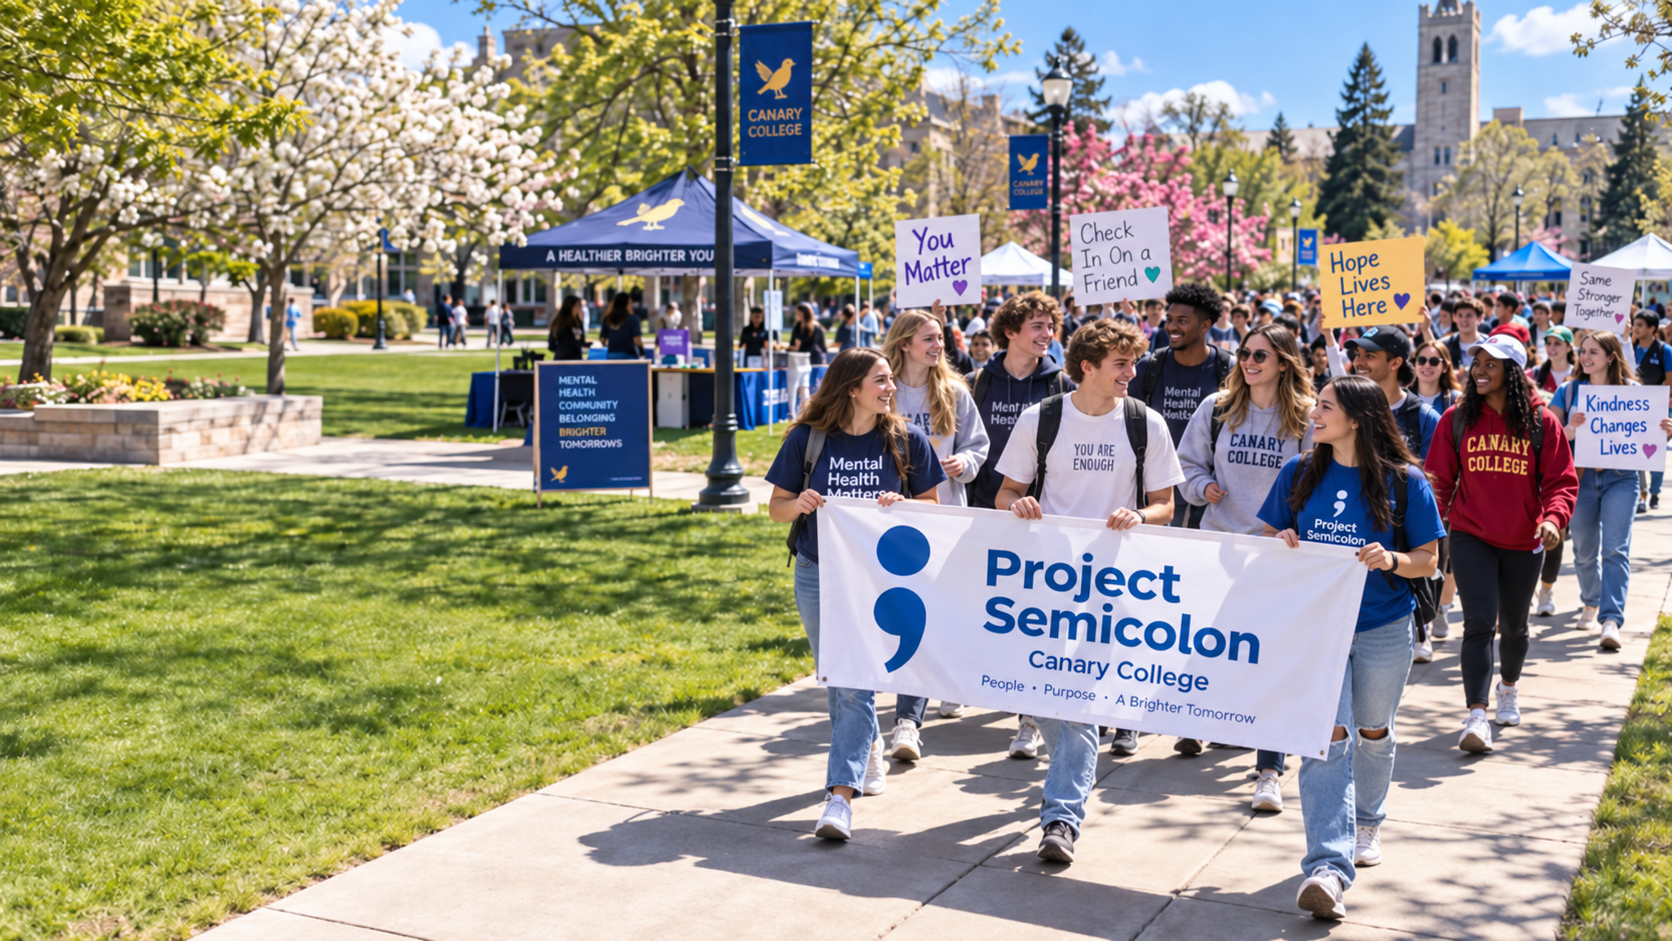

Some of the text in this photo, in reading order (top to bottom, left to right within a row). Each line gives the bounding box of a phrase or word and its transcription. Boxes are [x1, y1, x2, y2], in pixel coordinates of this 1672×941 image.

[748, 108, 802, 122] CANARY
[748, 123, 802, 137] COLLEGE
[1081, 220, 1134, 244] Check
[912, 227, 954, 255] You
[546, 250, 555, 261] A
[559, 250, 621, 261] HEALTHIER
[626, 250, 685, 261] BRIGHTER
[1081, 246, 1151, 268] In On a
[1330, 251, 1379, 275] Hope
[905, 256, 971, 285] Matter
[1580, 271, 1611, 286] Same
[1084, 268, 1138, 293] Friend
[1340, 276, 1390, 295] Lives
[1577, 288, 1622, 308] Stronger
[1342, 298, 1387, 318] Here
[1574, 304, 1614, 321] Together
[559, 376, 597, 384] MENTAL
[559, 388, 595, 397] HEALTH
[1165, 386, 1201, 397] Mental
[559, 400, 618, 410] COMMUNITY
[1164, 397, 1197, 408] Health
[1586, 395, 1649, 412] Kindness
[559, 413, 615, 423] BELONGING
[559, 427, 606, 436] BRIGHTER
[1591, 417, 1647, 437] Changes
[560, 439, 622, 448] TOMORROWS
[1074, 444, 1114, 457] YOU ARE
[1230, 434, 1285, 452] CANARY
[1467, 434, 1530, 456] CANARY
[1601, 439, 1637, 455] Lives
[830, 455, 882, 470] Mental
[1074, 458, 1114, 471] ENOUGH
[1228, 450, 1283, 469] COLLEGE
[1468, 456, 1528, 475] COLLEGE
[828, 472, 879, 486] Health
[1315, 518, 1357, 534] Project
[1308, 530, 1365, 545] Semicolon
[986, 549, 1181, 603] Project
[983, 597, 1260, 664] Semicolon
[1029, 650, 1208, 693] Canary College
[982, 675, 1256, 724] People Purpose A Brighter Tomorrow
